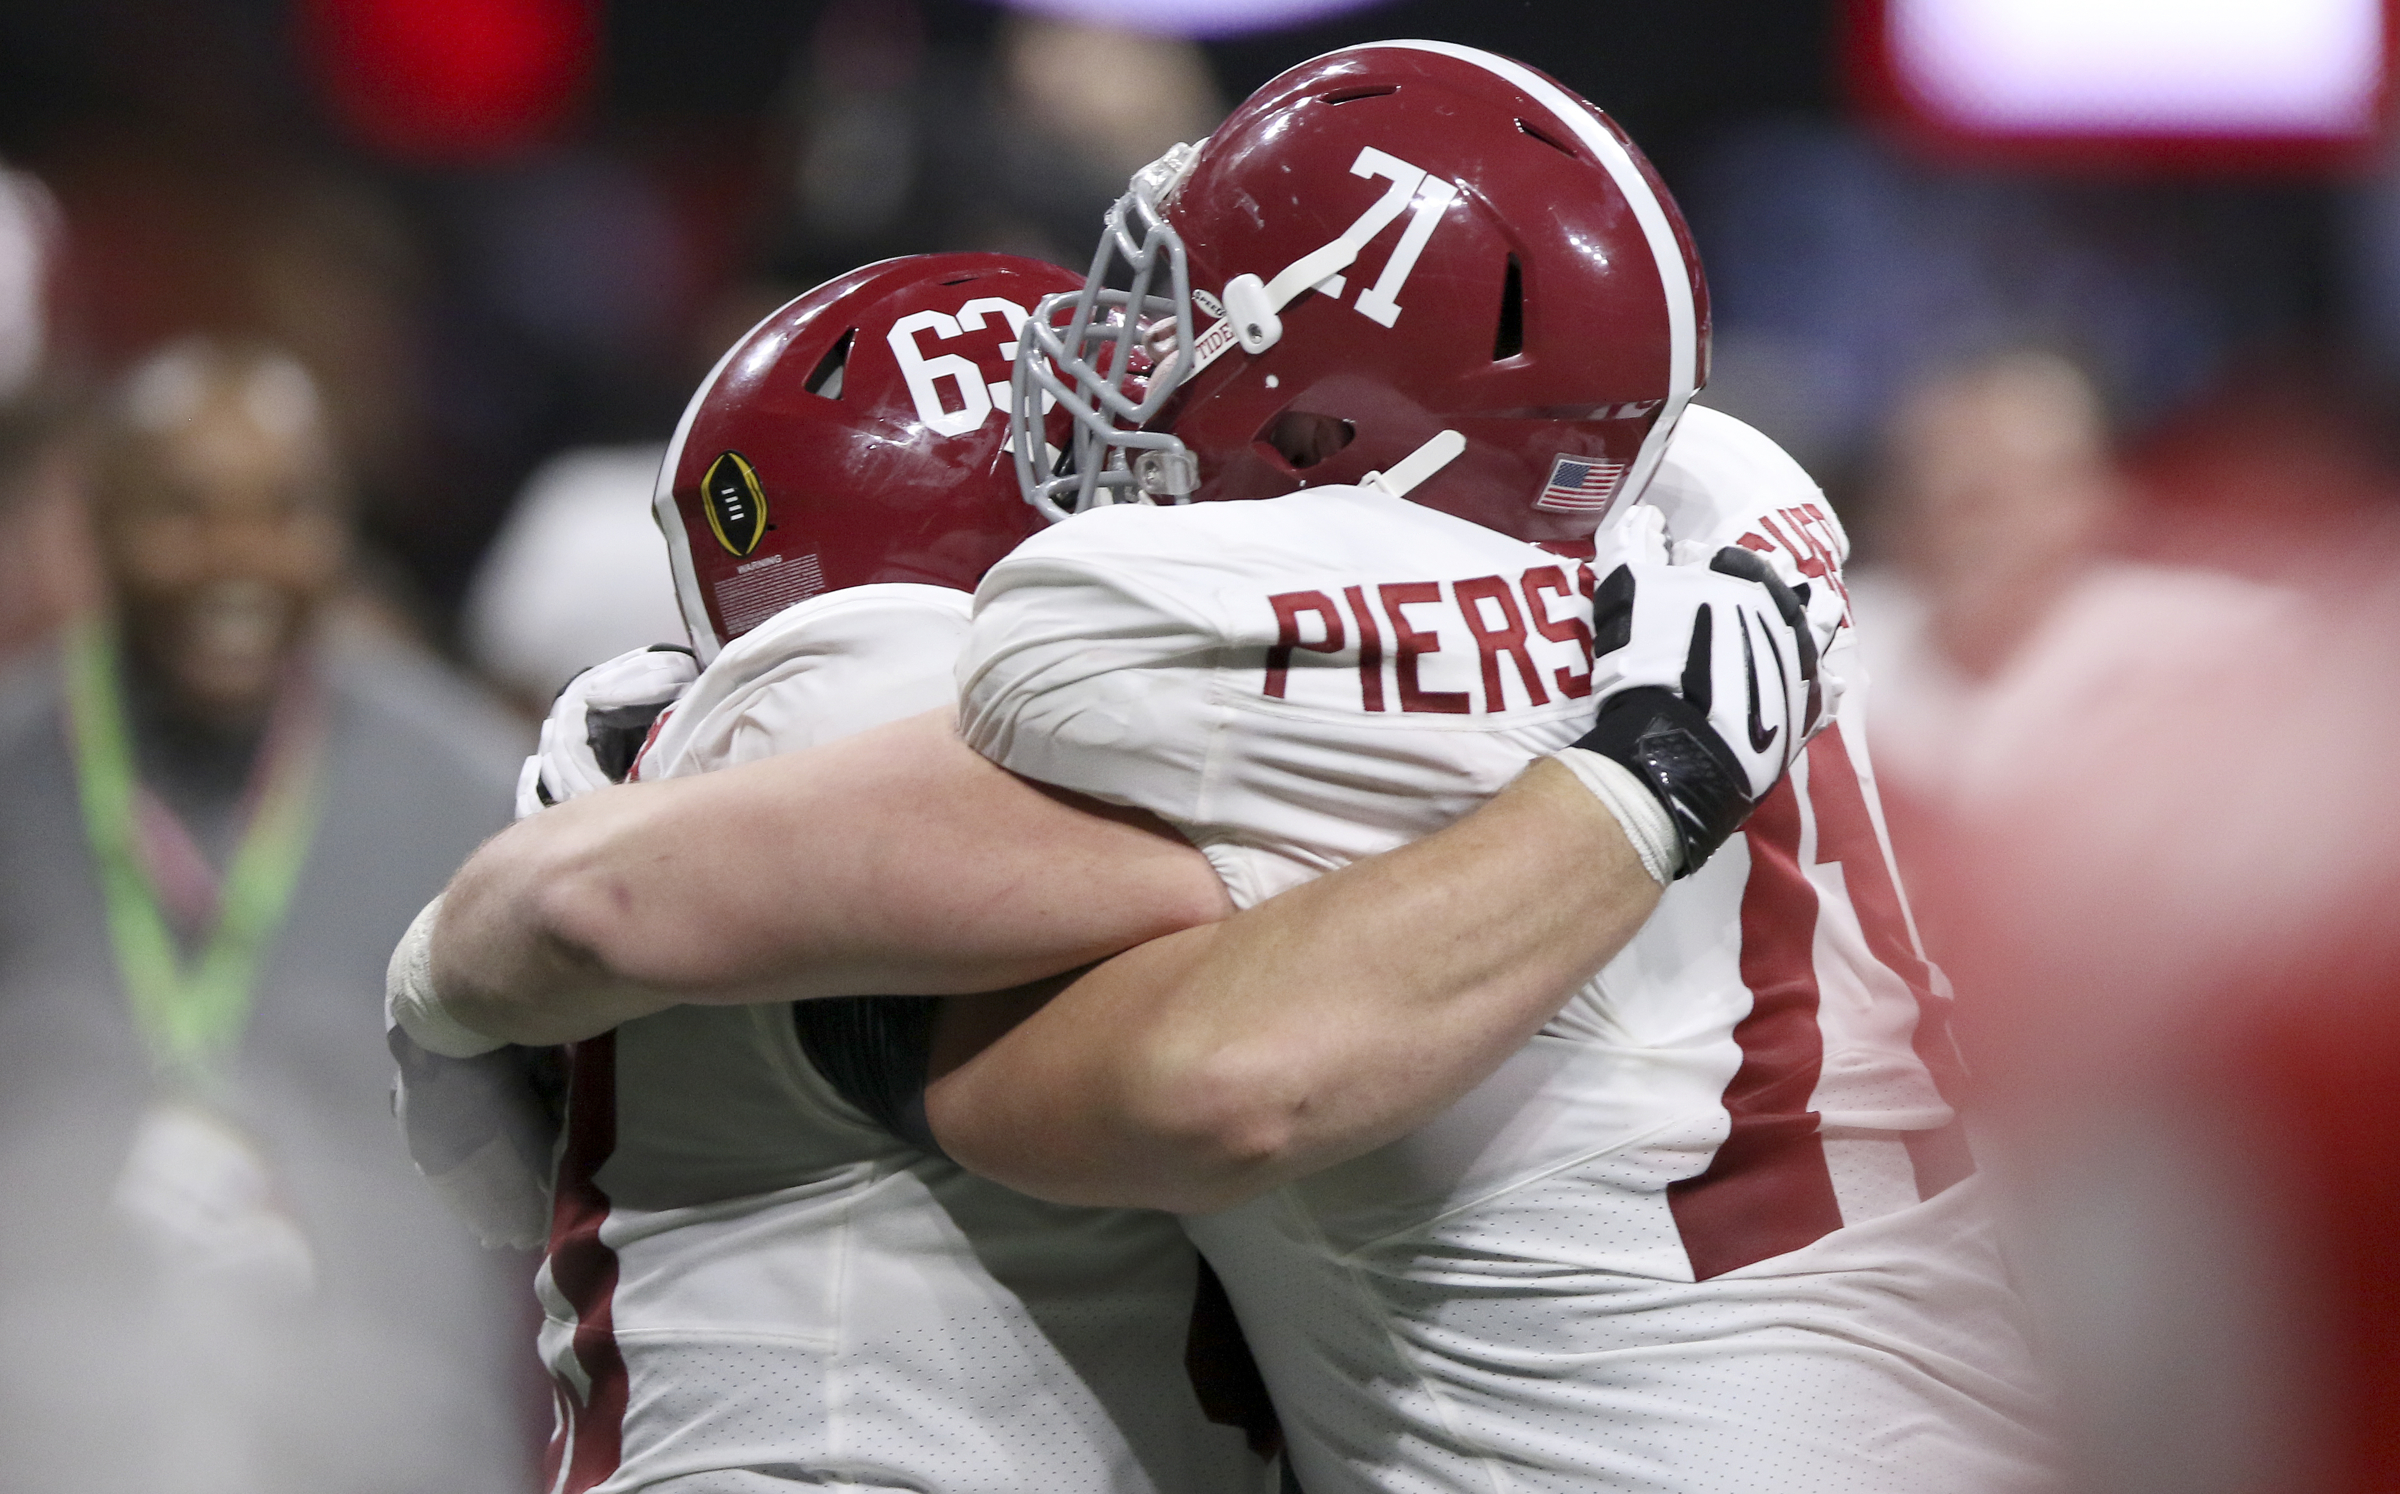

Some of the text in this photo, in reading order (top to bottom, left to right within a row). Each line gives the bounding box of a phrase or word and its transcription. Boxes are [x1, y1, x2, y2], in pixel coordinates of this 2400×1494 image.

[1313, 145, 1460, 328] 71
[886, 296, 1059, 438] 63
[1194, 322, 1236, 360] TIDE
[1262, 560, 1595, 714] PIERS
